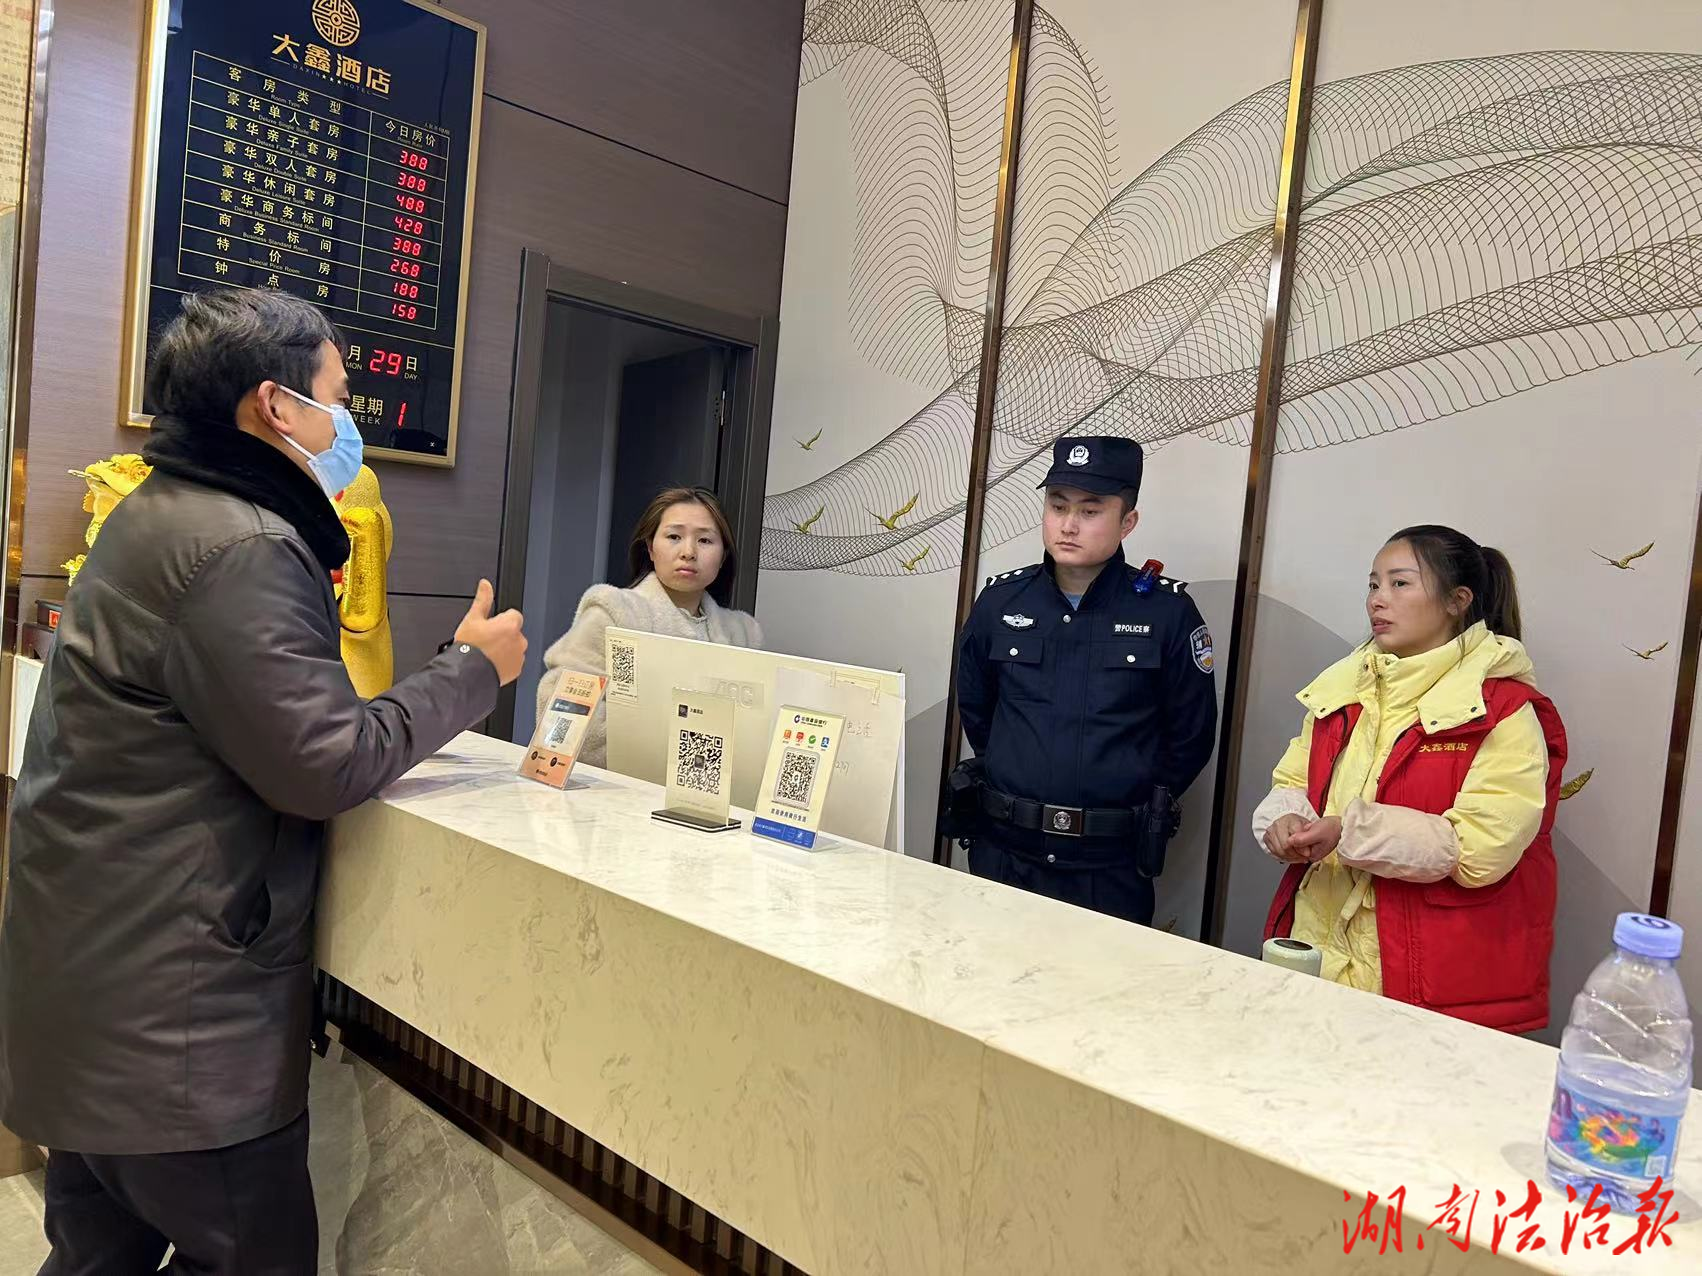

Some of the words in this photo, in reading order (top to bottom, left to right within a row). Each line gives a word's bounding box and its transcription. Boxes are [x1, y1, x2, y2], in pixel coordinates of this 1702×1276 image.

[272, 34, 391, 94] 大鑫酒店
[228, 65, 341, 115] 客房类型
[226, 89, 340, 139] 豪华单人套房
[224, 114, 338, 162] 豪华亲子套房
[384, 118, 436, 148] 今日房价
[223, 138, 337, 184] 豪华双人套房
[400, 150, 428, 171] 388
[221, 162, 335, 208] 豪华休闲套房
[397, 172, 426, 192] 388
[219, 187, 333, 230] 豪华商务标间
[396, 194, 425, 214] 488
[217, 211, 331, 253] 商务标间
[394, 216, 423, 235] 428
[216, 235, 331, 276] 特价房
[393, 237, 421, 256] 388
[214, 259, 329, 299] 钟点房
[390, 259, 420, 278] 268
[393, 282, 418, 299] 188
[392, 304, 416, 320] 158
[345, 362, 362, 370] MON
[404, 372, 418, 380] DAY
[348, 345, 361, 361] 月
[370, 349, 402, 375] 29
[406, 356, 417, 372] 日
[350, 395, 383, 416] 星期
[397, 402, 406, 427] 1
